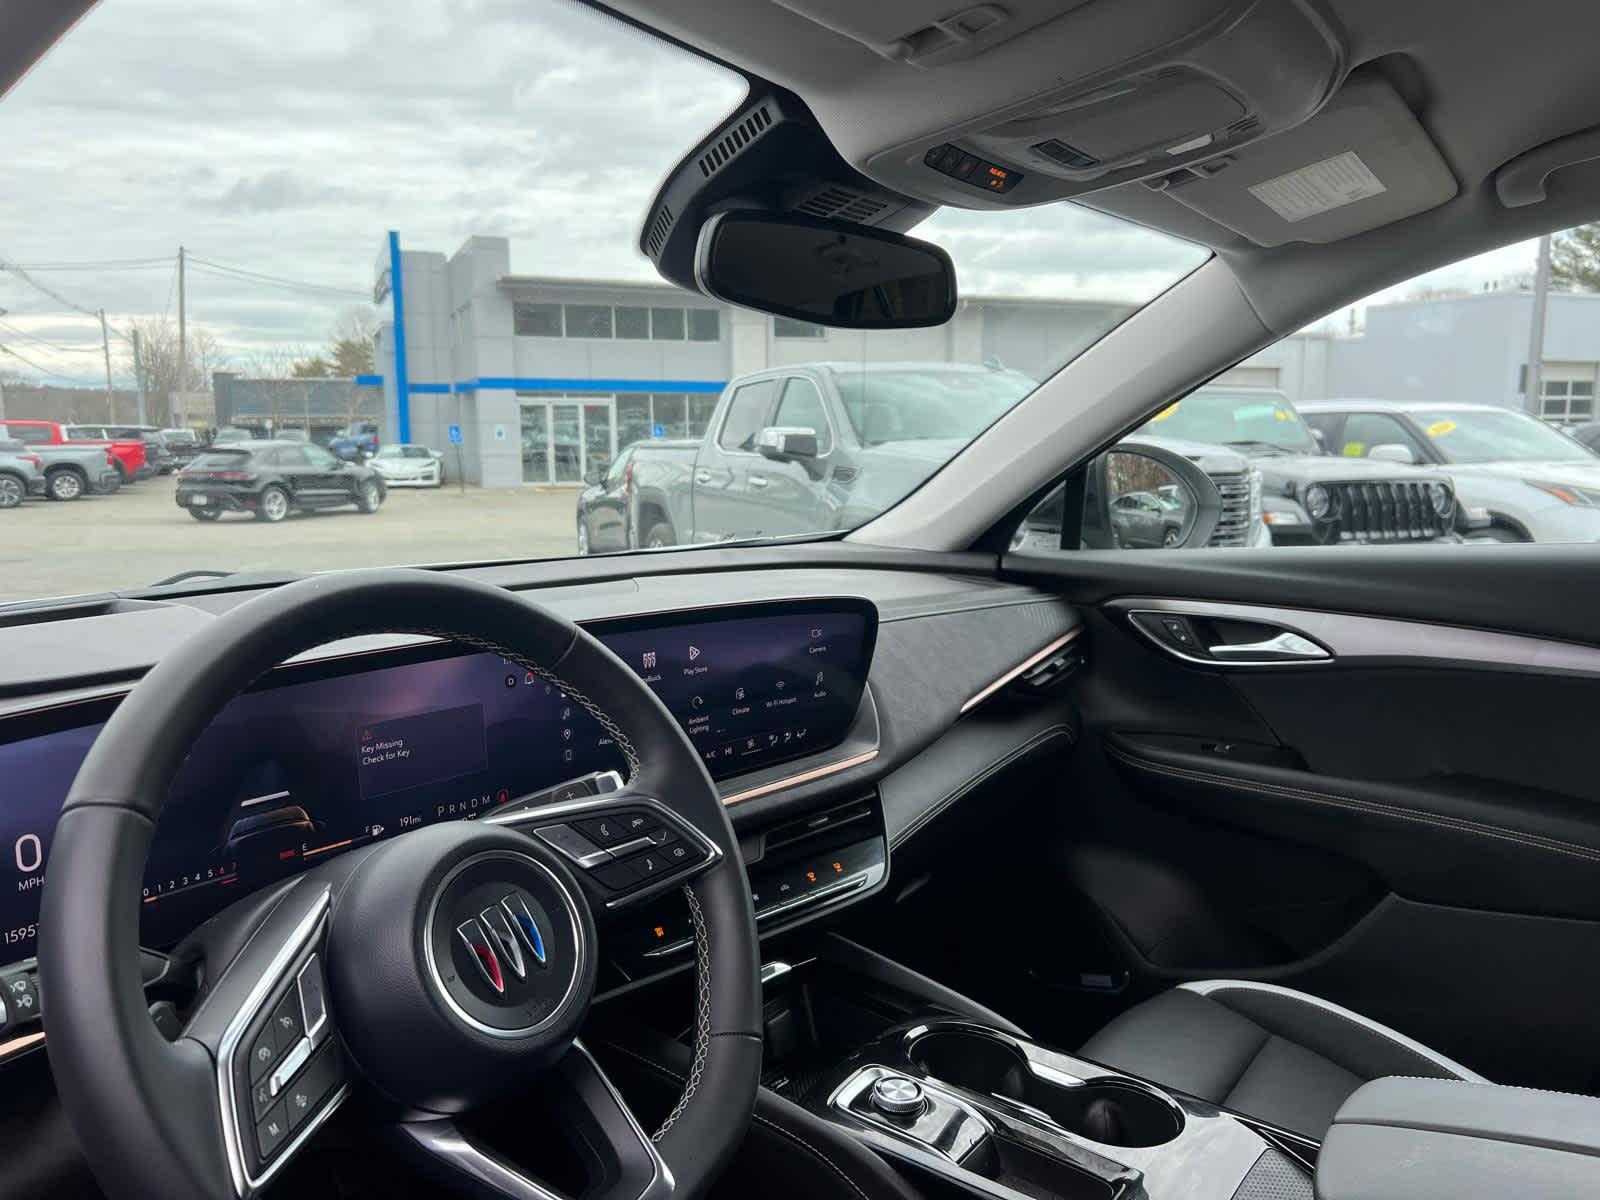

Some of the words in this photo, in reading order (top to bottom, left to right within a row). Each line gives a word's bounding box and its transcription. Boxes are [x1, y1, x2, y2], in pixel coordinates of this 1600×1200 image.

[361, 745, 375, 754] Key
[375, 739, 403, 750] Missing
[362, 754, 385, 766] Check
[385, 751, 396, 761] for
[397, 749, 411, 761] Key
[15, 833, 43, 872] 0
[18, 875, 45, 892] MPH
